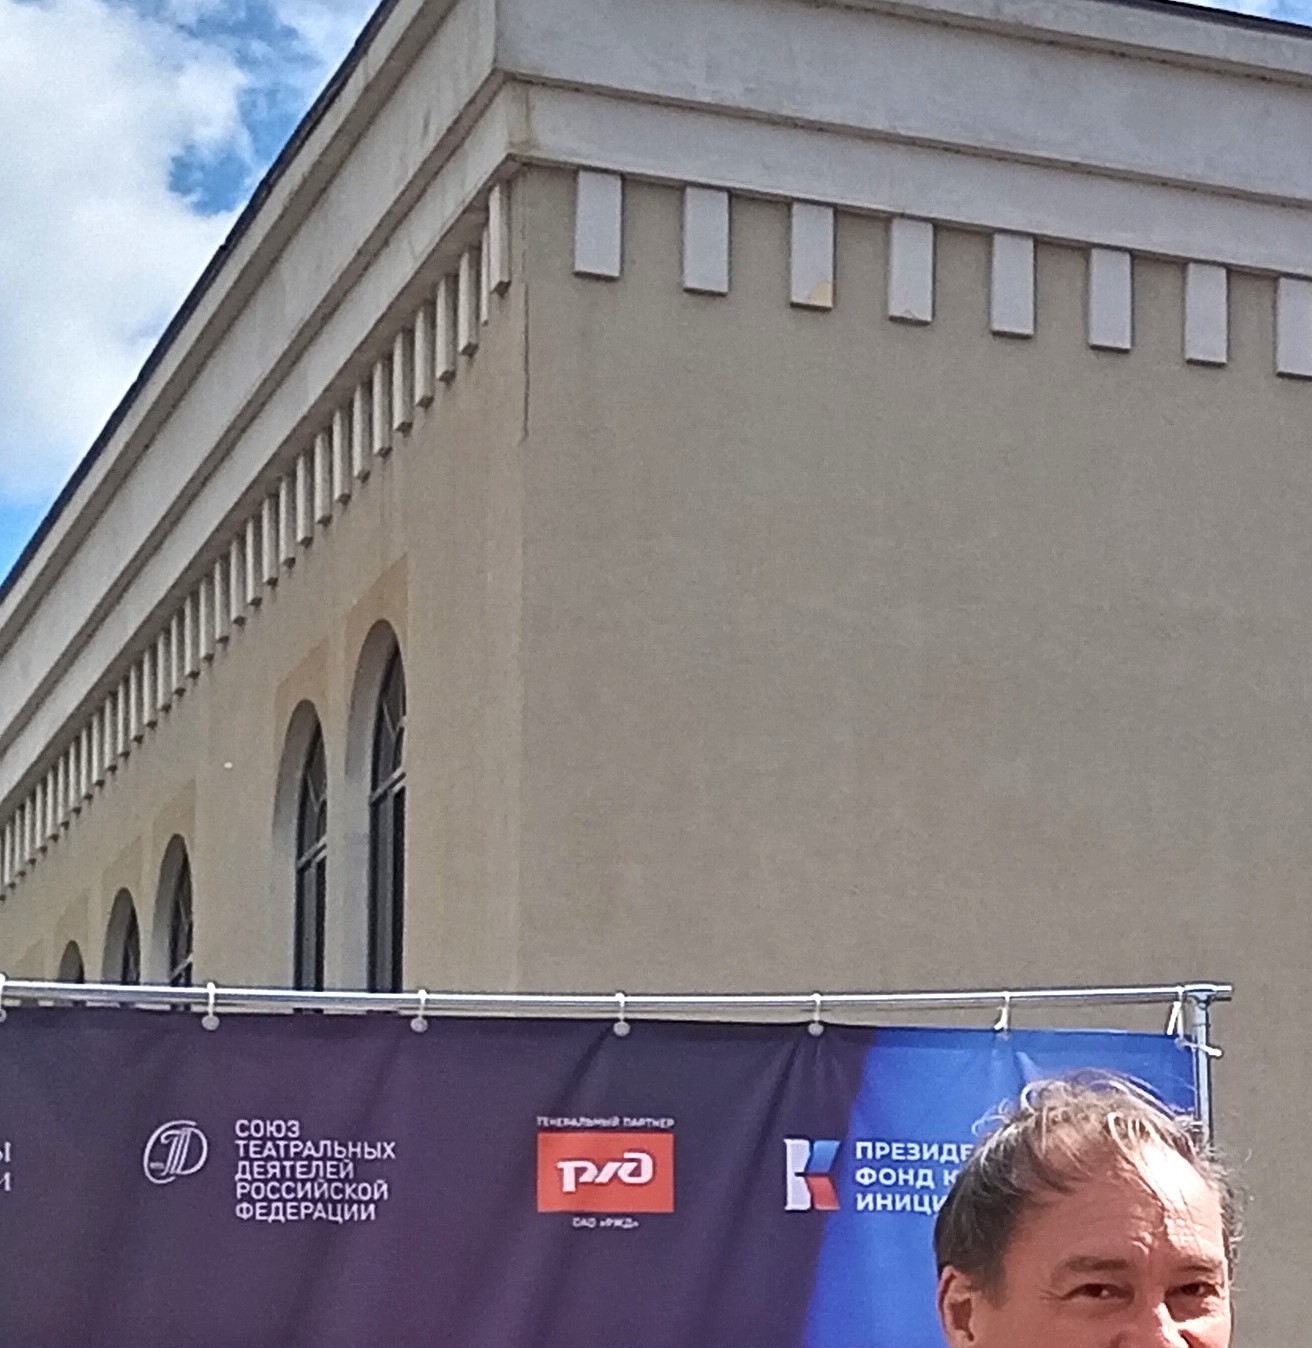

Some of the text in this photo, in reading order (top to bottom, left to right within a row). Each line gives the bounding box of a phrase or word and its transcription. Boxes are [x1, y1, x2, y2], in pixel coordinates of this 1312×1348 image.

[235, 1119, 300, 1138] СОЮЗ
[235, 1140, 396, 1160] ТЕАТРАЛЬНЫХ
[235, 1159, 354, 1181] ДЕЯТЕЛЕЙ
[855, 1167, 935, 1189] ФОНД
[236, 1179, 388, 1200] РОССИЙСКОЙ
[235, 1202, 376, 1223] ФЕДЕРАЦИИ
